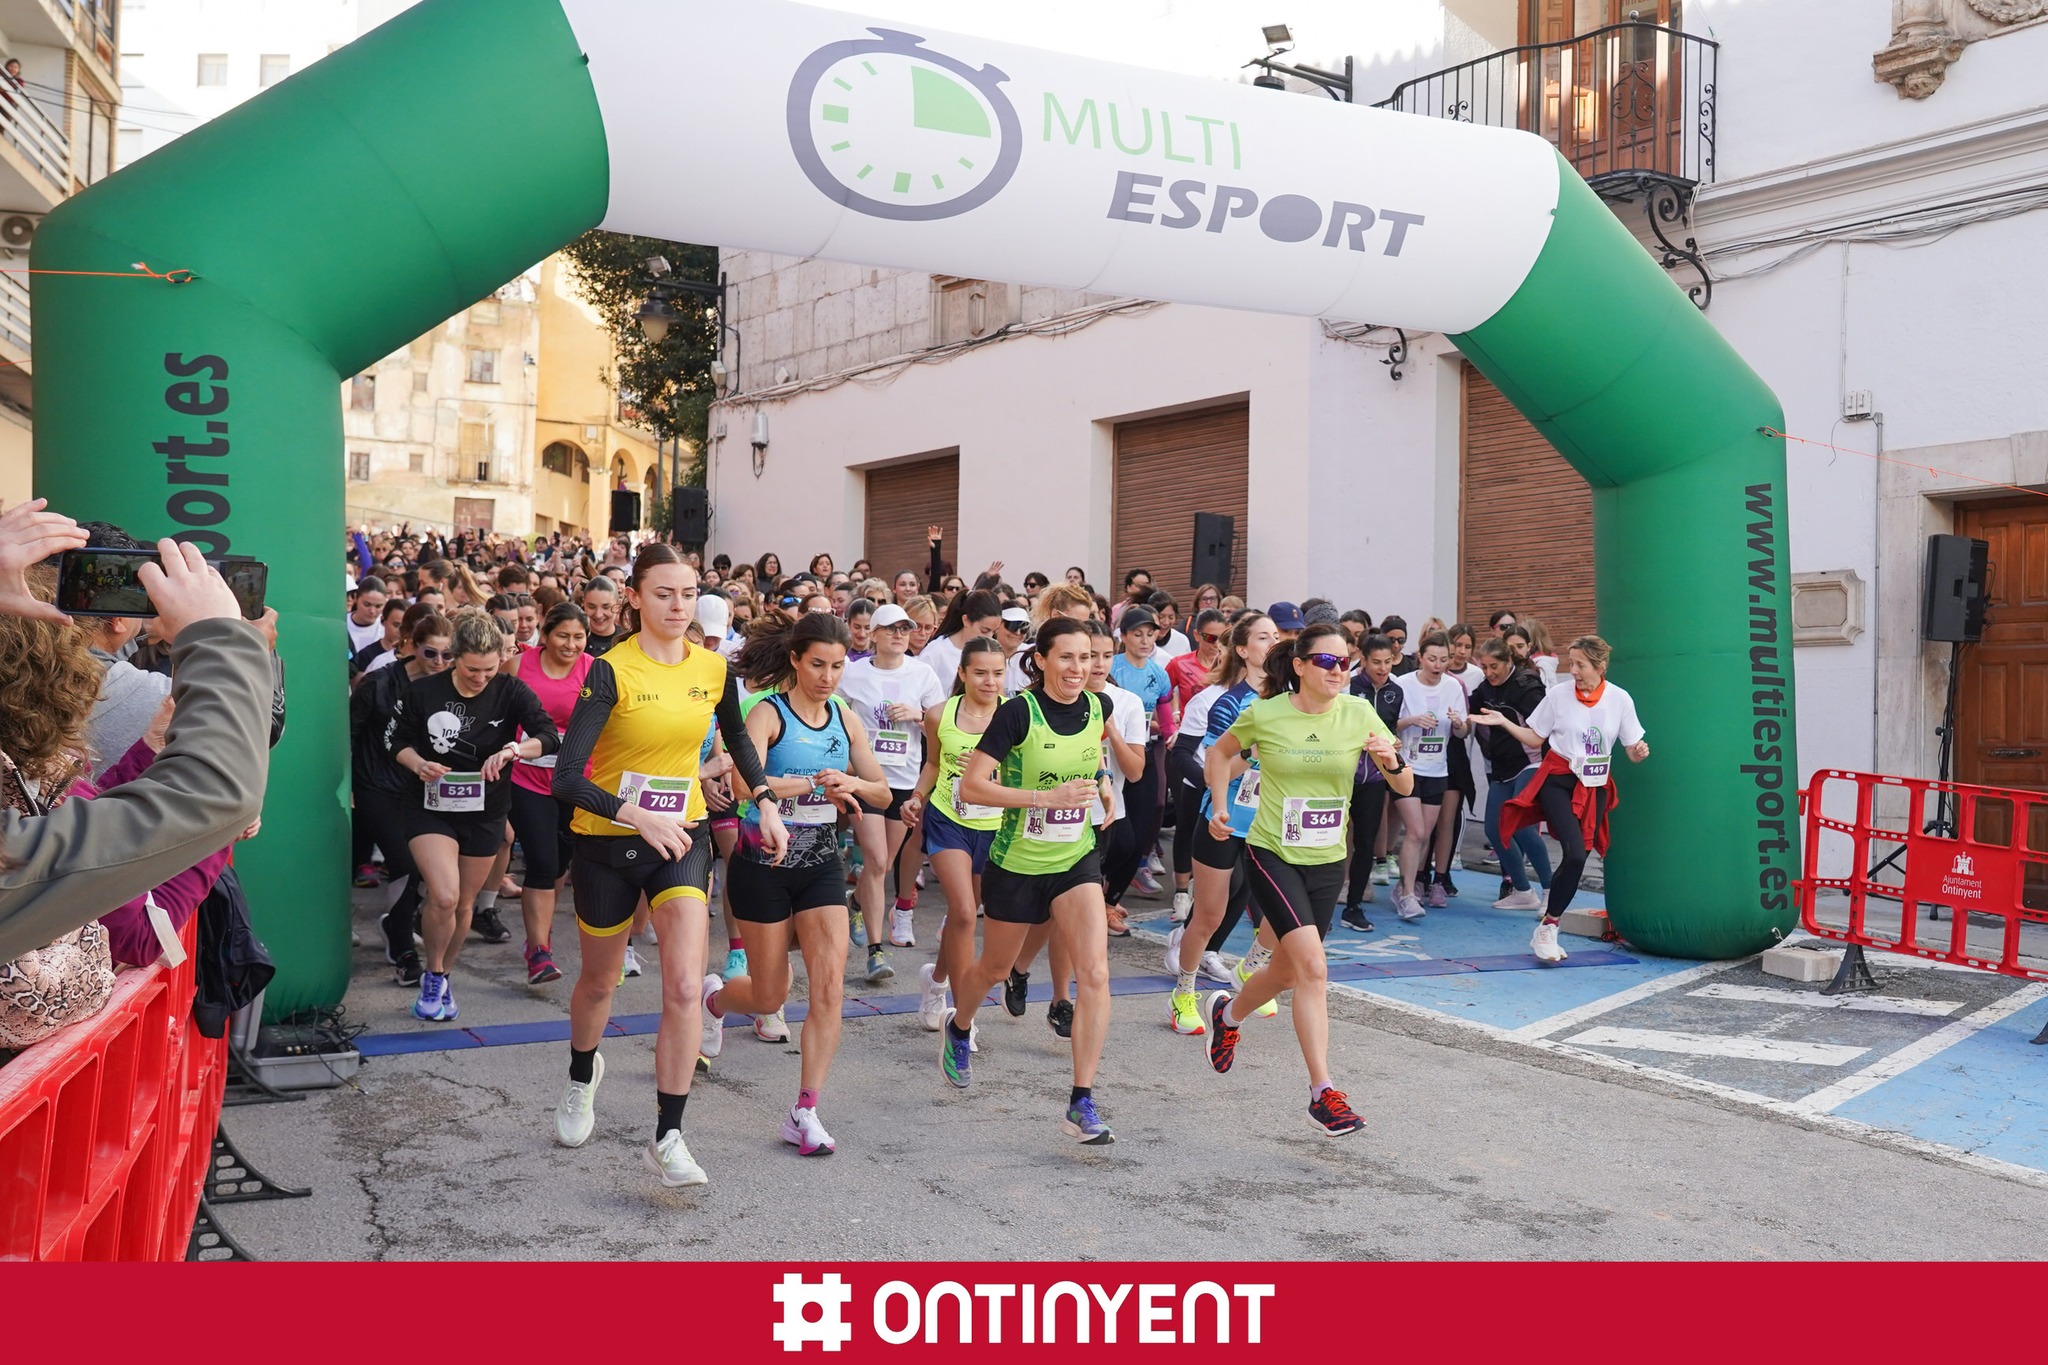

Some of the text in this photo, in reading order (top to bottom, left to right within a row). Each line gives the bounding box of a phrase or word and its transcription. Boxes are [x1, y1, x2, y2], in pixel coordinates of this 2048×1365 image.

[1042, 92, 1242, 171] MULTI
[1106, 170, 1426, 258] ESPORT
[1740, 483, 1790, 911] www.multiesport.es
[880, 742, 902, 751] 433
[1302, 755, 1322, 763] 1000
[1589, 766, 1604, 775] 149
[448, 785, 473, 796] 521
[650, 794, 677, 808] 702
[1054, 809, 1080, 820] 834
[1309, 813, 1336, 825] 364
[1942, 875, 1982, 889] Ajuntament
[1941, 883, 1982, 900] Ontinyent
